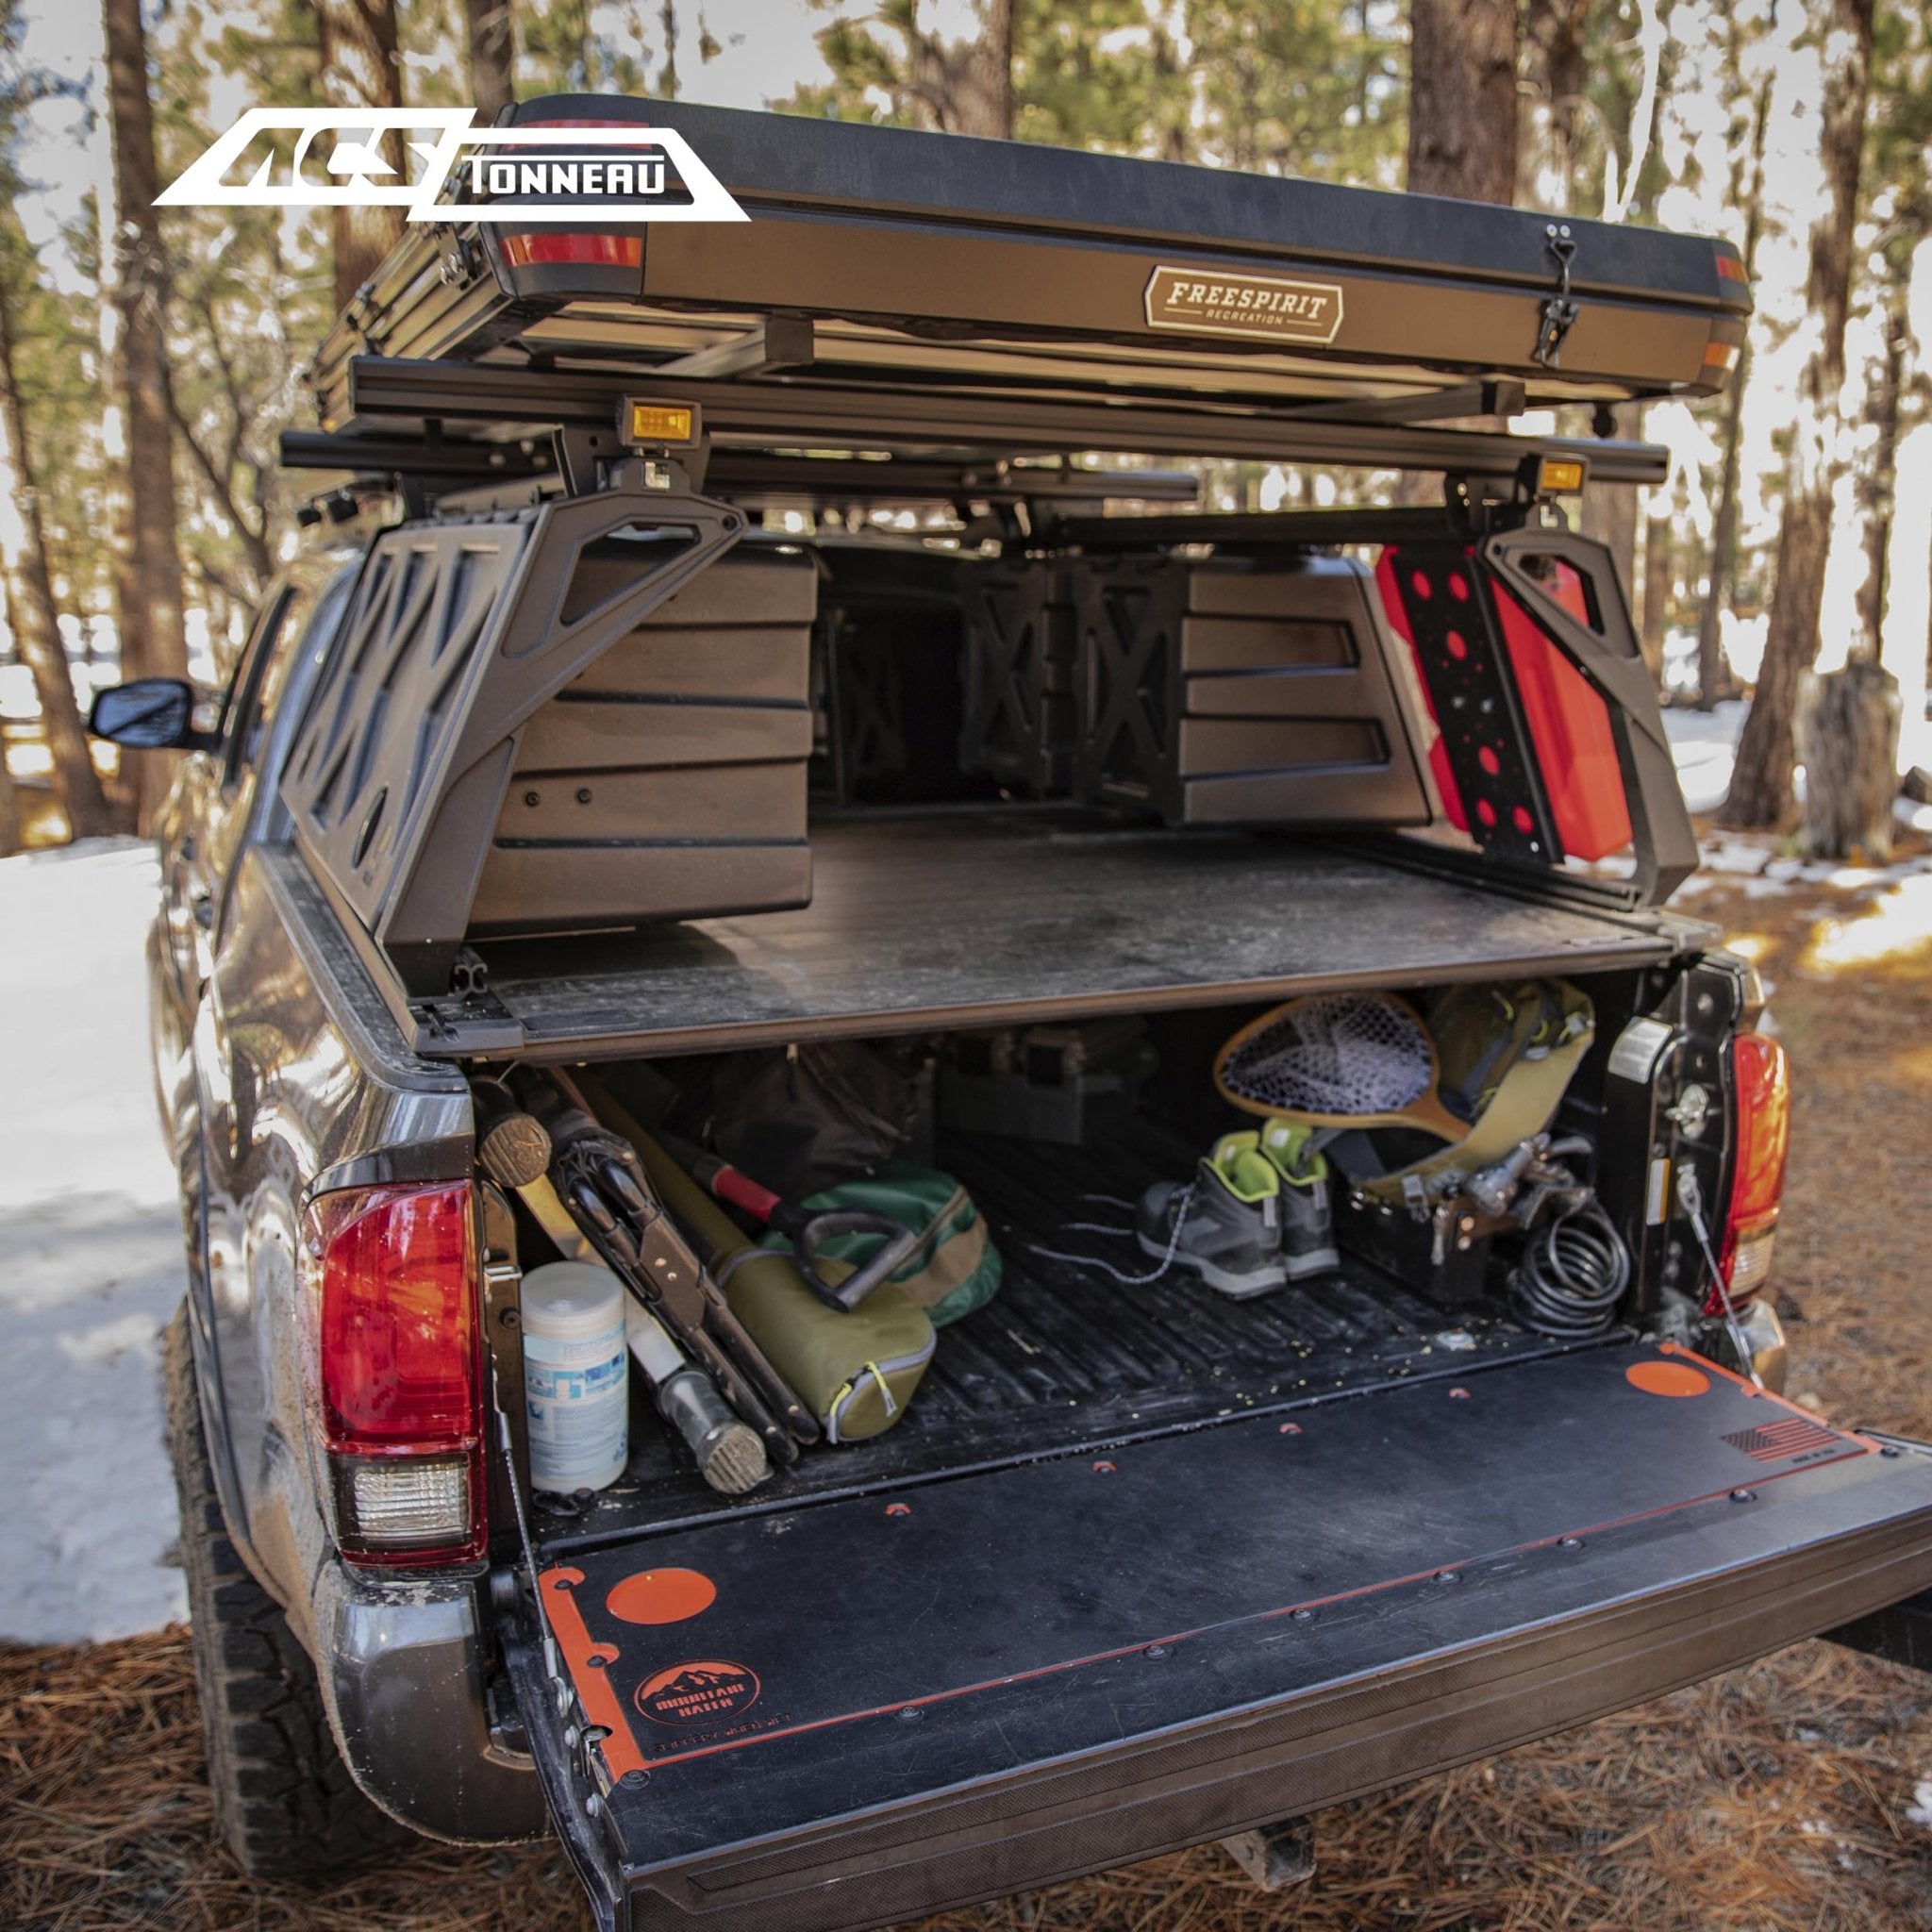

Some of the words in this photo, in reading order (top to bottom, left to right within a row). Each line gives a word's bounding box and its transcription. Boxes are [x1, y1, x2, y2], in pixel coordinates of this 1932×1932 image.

[1166, 282, 1326, 319] FREESPIRIT
[1206, 308, 1284, 325] RECREATION
[656, 1684, 744, 1710] MOUNTAIN
[678, 1698, 733, 1717] HATCH
